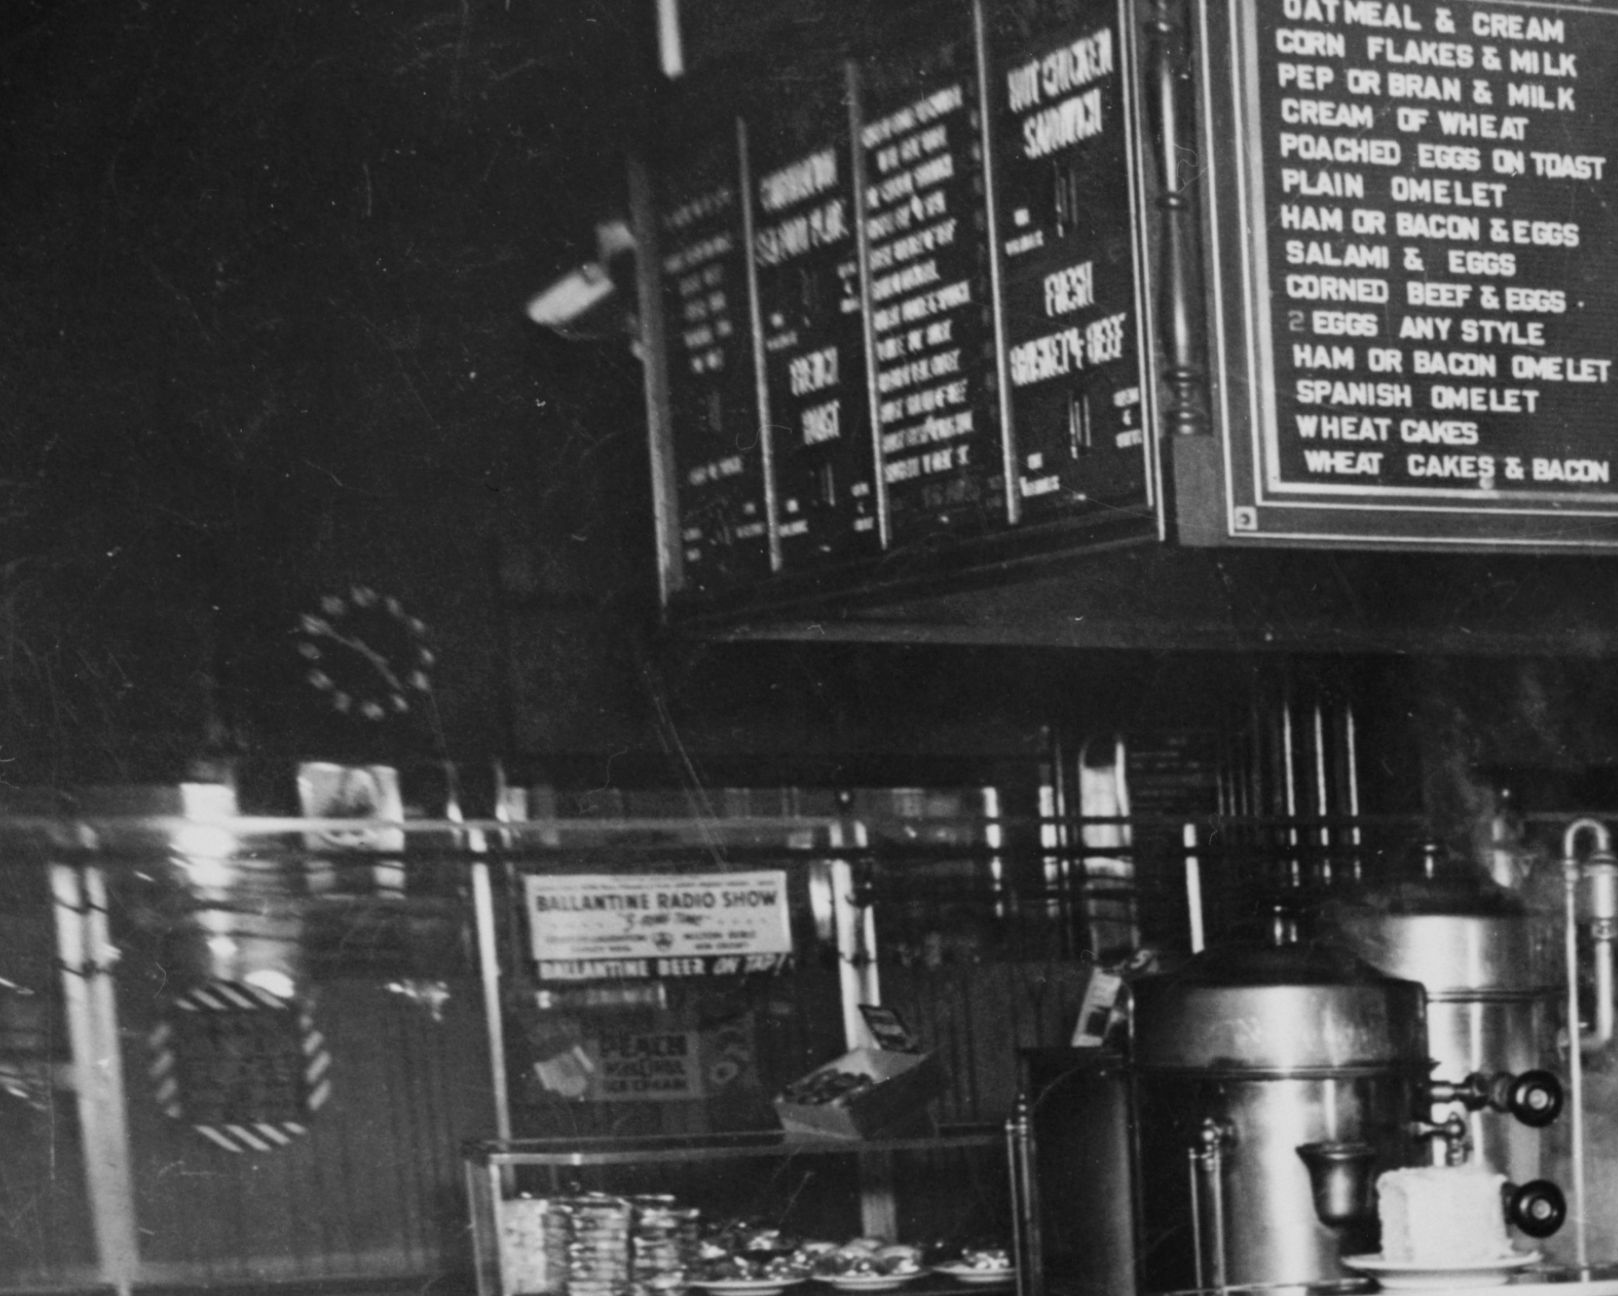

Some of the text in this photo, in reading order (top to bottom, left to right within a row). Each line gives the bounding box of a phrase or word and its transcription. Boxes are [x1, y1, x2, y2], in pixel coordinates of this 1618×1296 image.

[1283, 0, 1421, 32] OATMEAL
[1436, 8, 1455, 33] &
[1473, 12, 1564, 43] CREAM
[1276, 29, 1345, 58] CORN
[1368, 37, 1473, 68] FLAKES
[1482, 46, 1502, 71] &
[1510, 49, 1577, 77] MILK
[1280, 132, 1400, 166] POACHED
[1417, 143, 1480, 171] EGGS
[1492, 148, 1524, 175] ON
[1531, 152, 1605, 180] TOAST
[1282, 168, 1363, 198] PLAIN
[1391, 177, 1506, 207] OMELET
[1286, 240, 1389, 269] SALAMI
[1403, 247, 1424, 272] &
[1448, 250, 1516, 276] EGGS
[1286, 274, 1389, 303] CORNED
[1407, 282, 1472, 307] BEEF
[1480, 285, 1500, 310] &
[1505, 287, 1566, 313] EGGS
[1293, 344, 1354, 371] HAM
[1368, 348, 1403, 374] OR
[1413, 350, 1496, 378] BACON
[1512, 355, 1611, 383] OMELET
[1295, 415, 1391, 442] WHEAT
[1400, 419, 1478, 445] CAKES
[1304, 450, 1383, 476] WHEAT
[1407, 454, 1495, 480] CAKES
[1505, 457, 1523, 480] &
[1533, 458, 1609, 484] BACON
[536, 889, 777, 912] BALLANTINE RADIO SHOW
[539, 960, 649, 979] BALLANTINE
[658, 958, 705, 975] BEER
